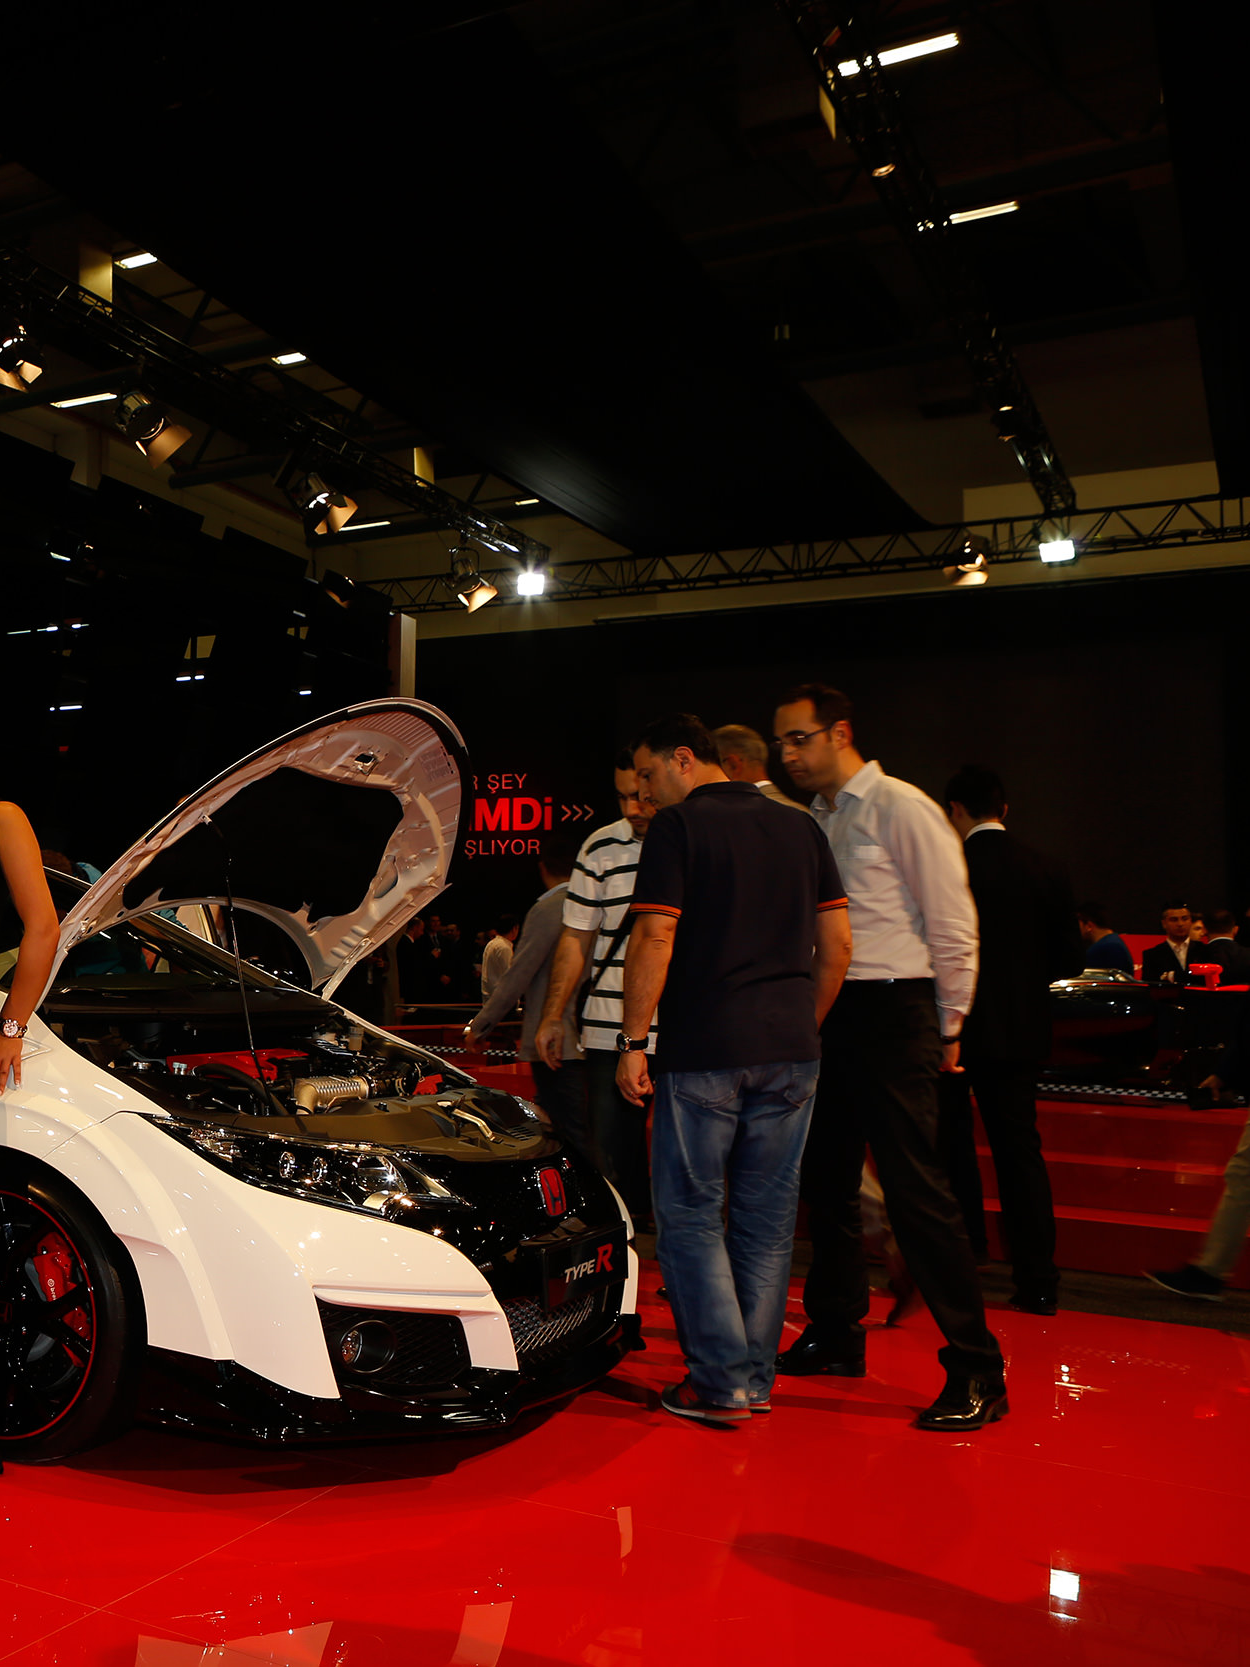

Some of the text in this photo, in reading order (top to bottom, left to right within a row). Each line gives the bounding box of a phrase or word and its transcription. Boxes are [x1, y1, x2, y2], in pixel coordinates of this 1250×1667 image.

[487, 774, 527, 794] ŞEY
[469, 797, 553, 831] MDi
[465, 840, 540, 860] ŞLIYOR
[565, 1243, 613, 1283] TYPE R
